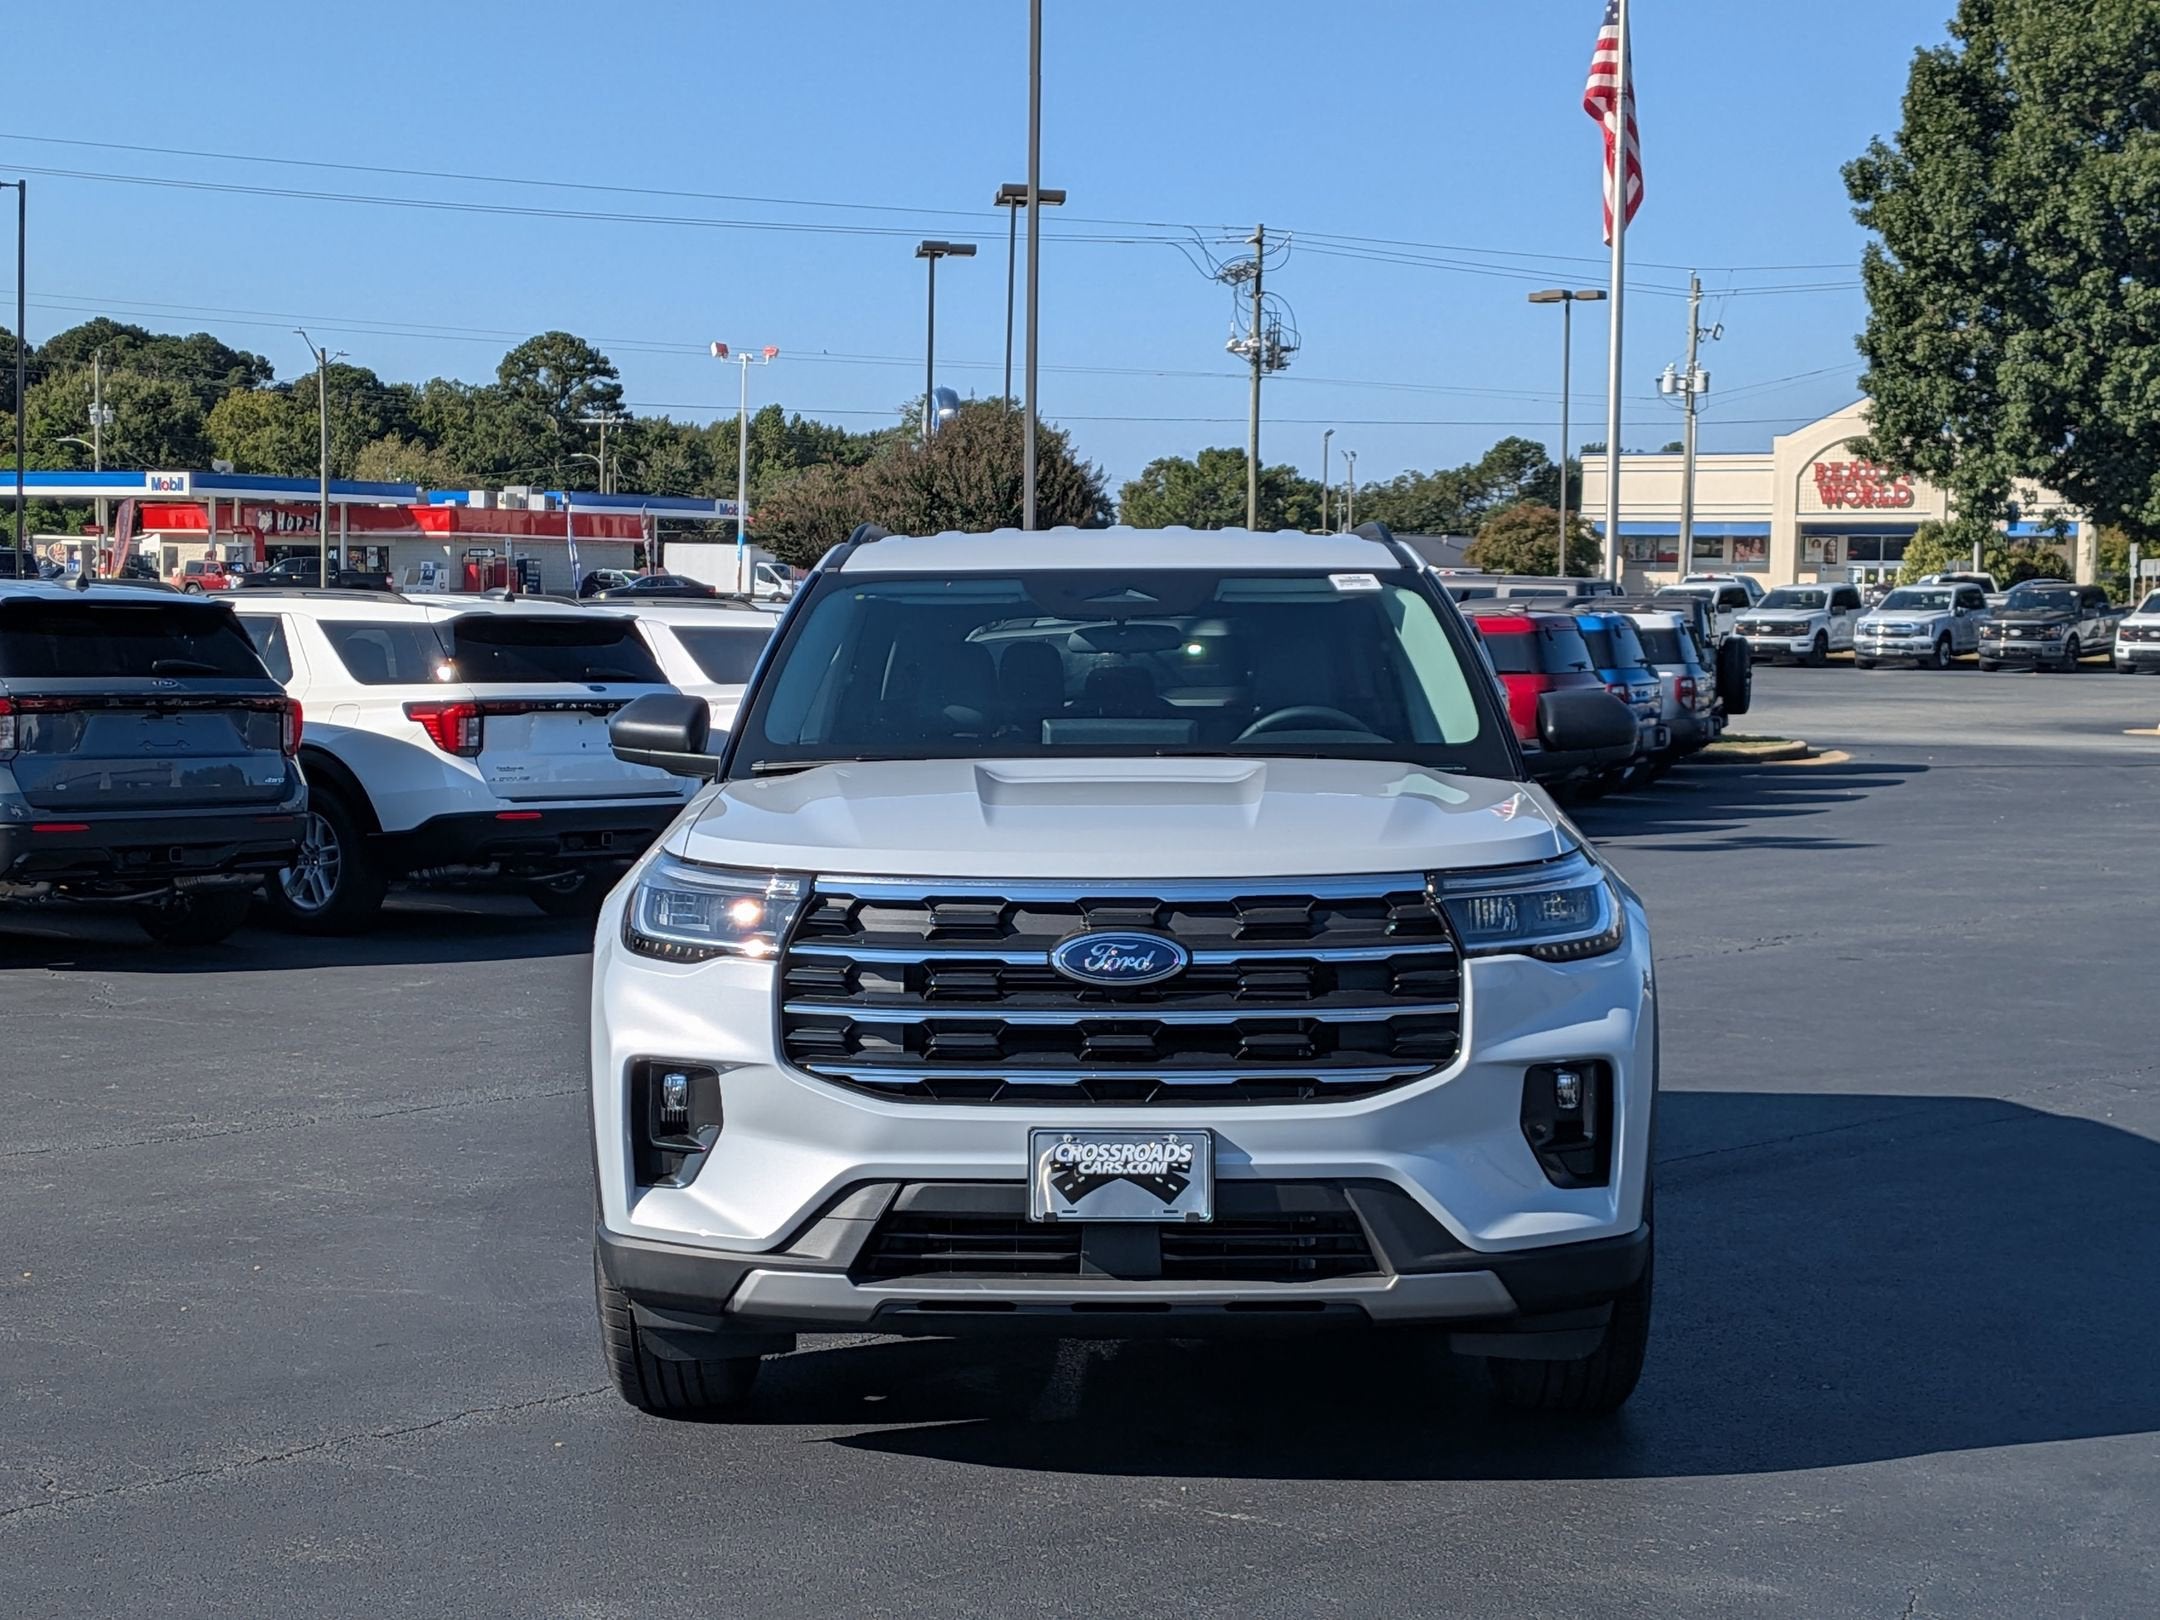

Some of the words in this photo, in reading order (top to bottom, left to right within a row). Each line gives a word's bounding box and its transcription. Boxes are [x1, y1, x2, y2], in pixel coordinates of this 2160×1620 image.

[1813, 460, 1912, 481] BEAU
[151, 476, 184, 491] Mobil
[1818, 484, 1912, 507] WORLD
[719, 503, 742, 516] Mob
[1084, 942, 1156, 972] Ford
[1054, 1143, 1194, 1163] CROSSROADS
[1077, 1161, 1169, 1175] CARS.COM
